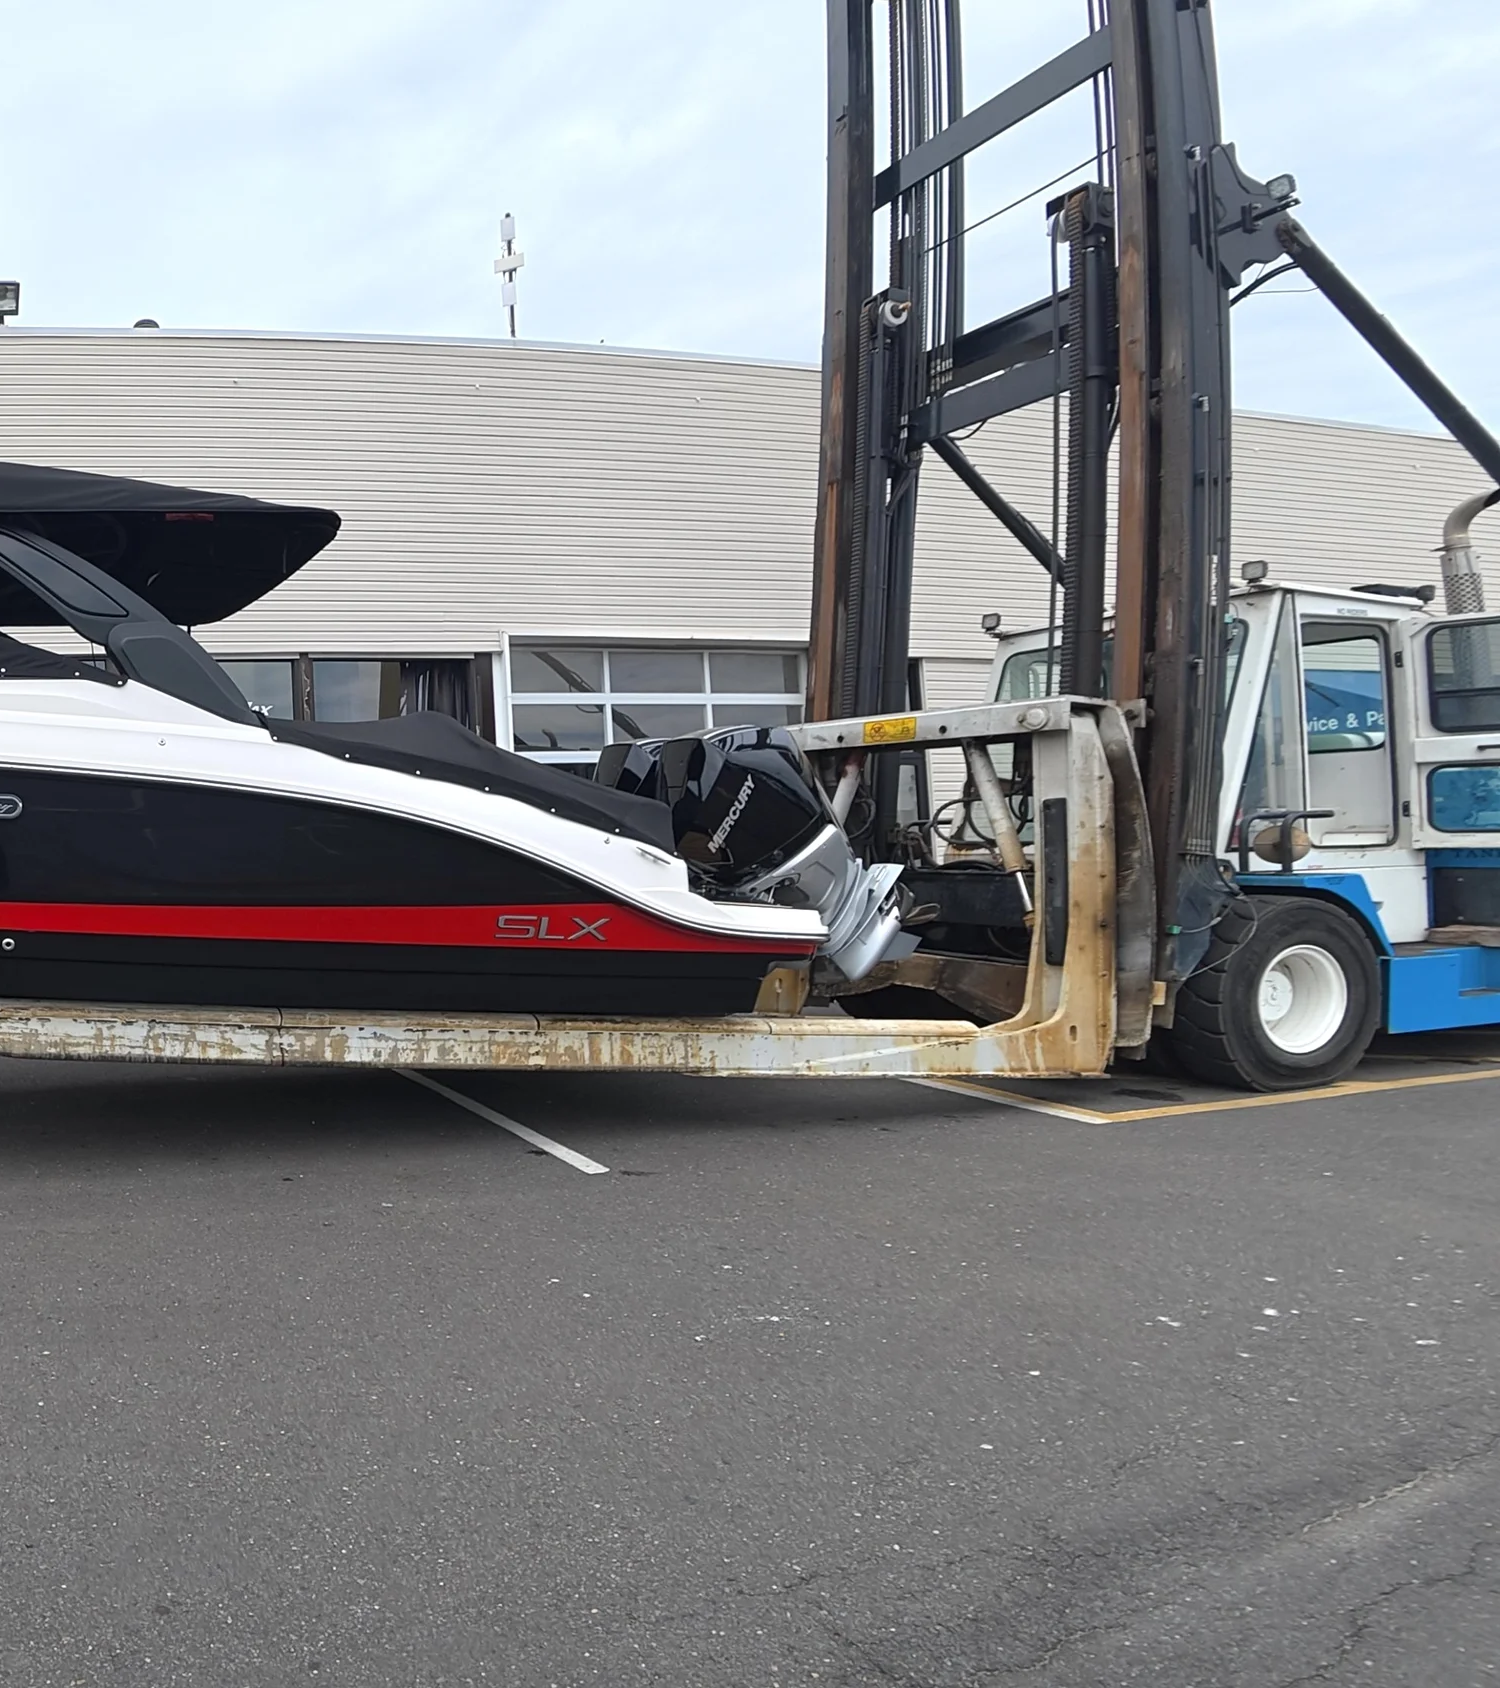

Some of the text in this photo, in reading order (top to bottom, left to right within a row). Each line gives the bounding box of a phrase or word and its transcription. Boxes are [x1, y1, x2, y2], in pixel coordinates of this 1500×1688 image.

[1346, 712, 1359, 729] &
[707, 773, 755, 854] MERCURY
[494, 914, 611, 941] SLX
